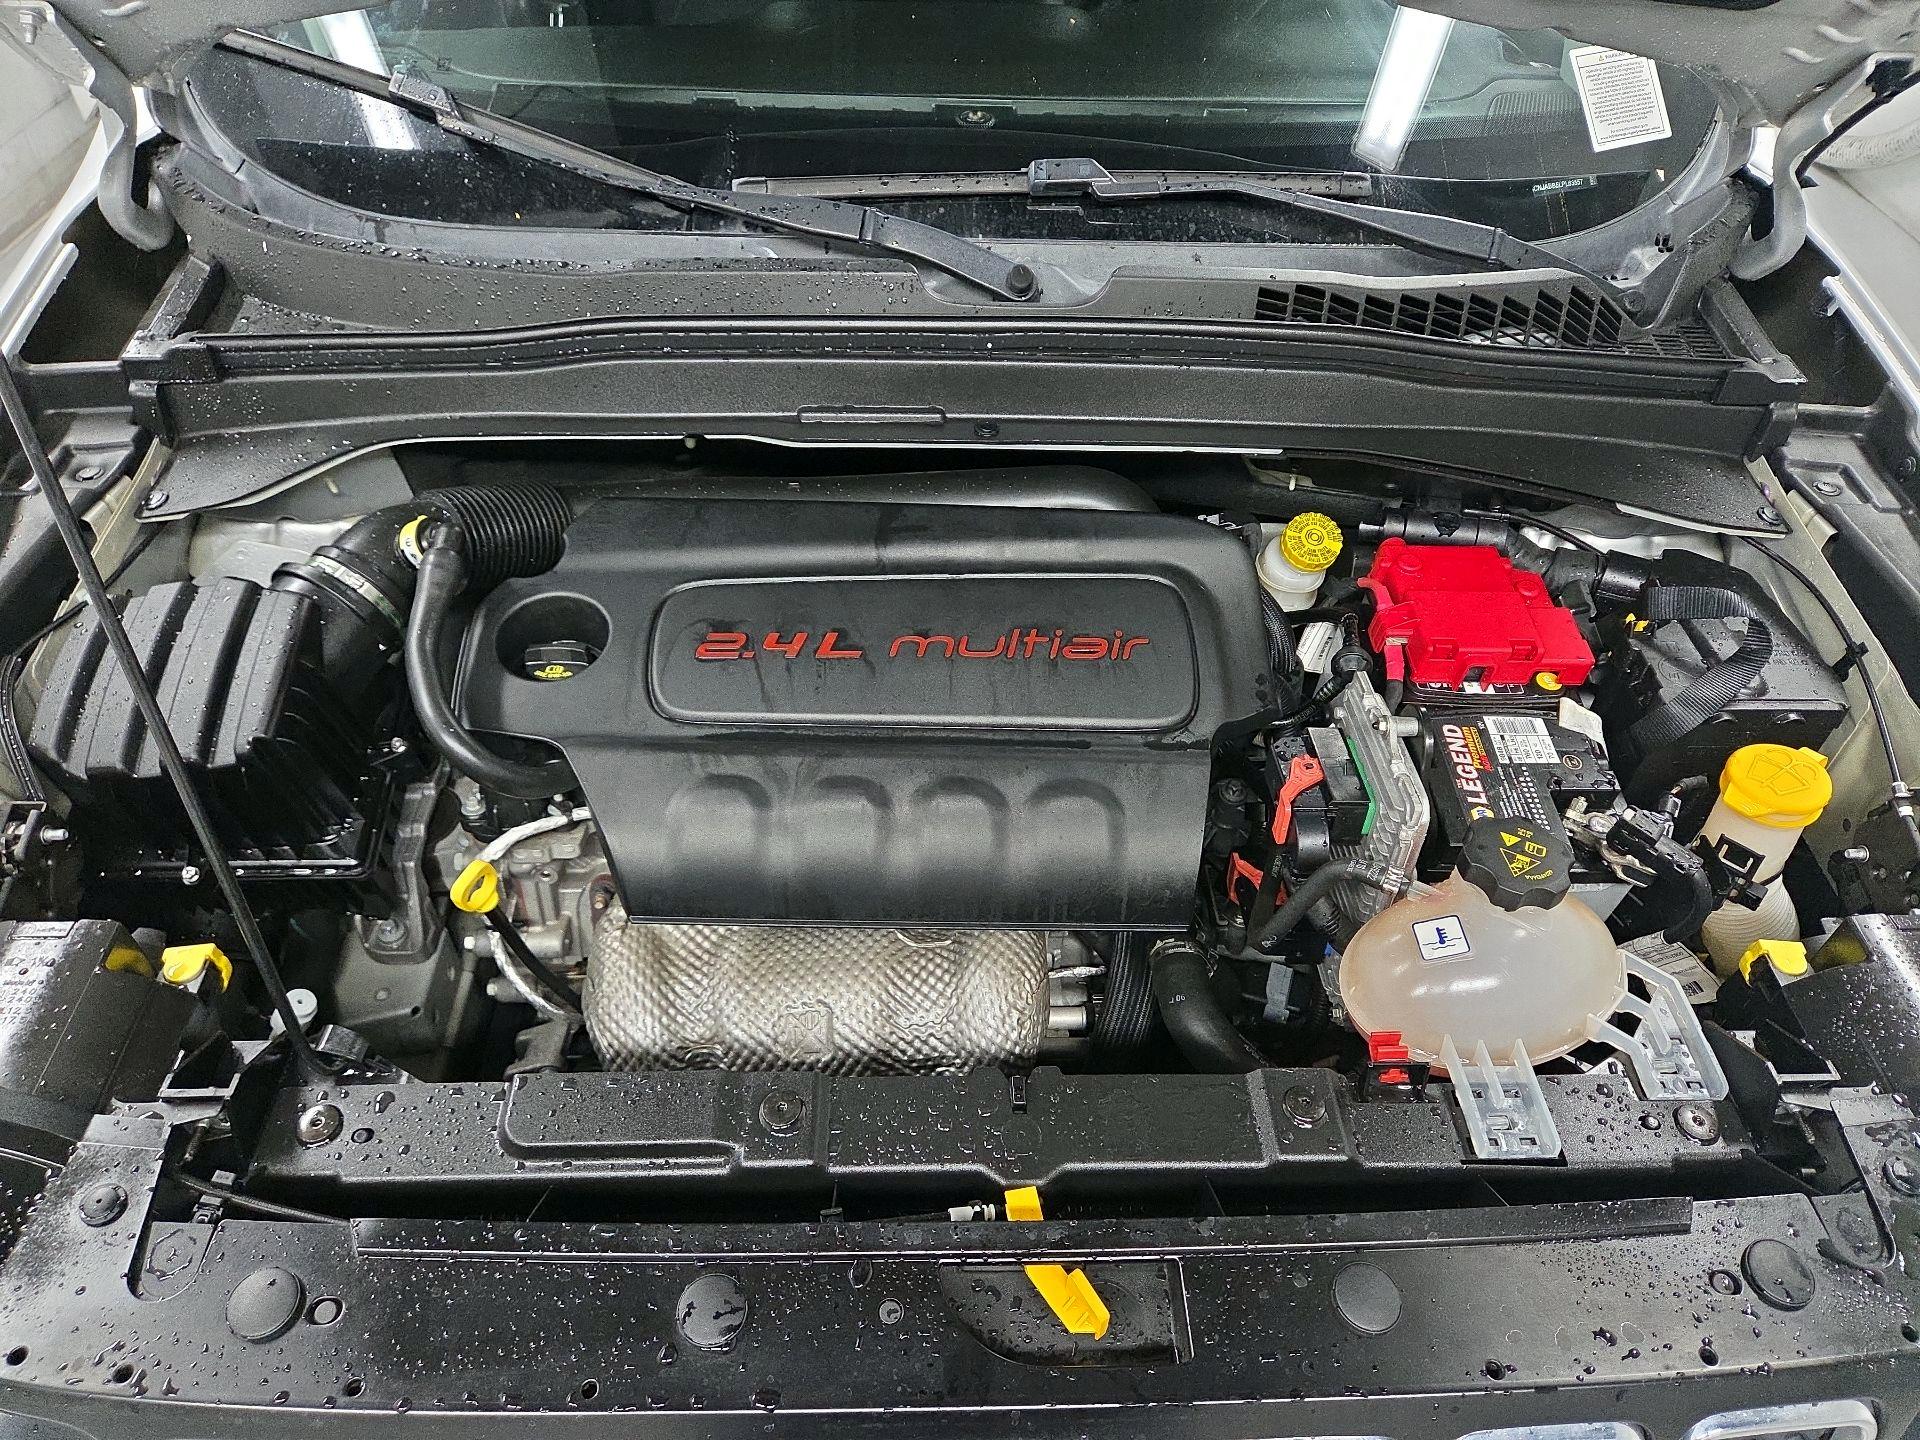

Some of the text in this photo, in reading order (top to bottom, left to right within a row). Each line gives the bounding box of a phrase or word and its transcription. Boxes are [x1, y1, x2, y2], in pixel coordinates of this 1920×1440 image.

[889, 627, 1151, 660] multiair
[1442, 724, 1489, 805] LEGEND
[1461, 726, 1484, 769] Premium
